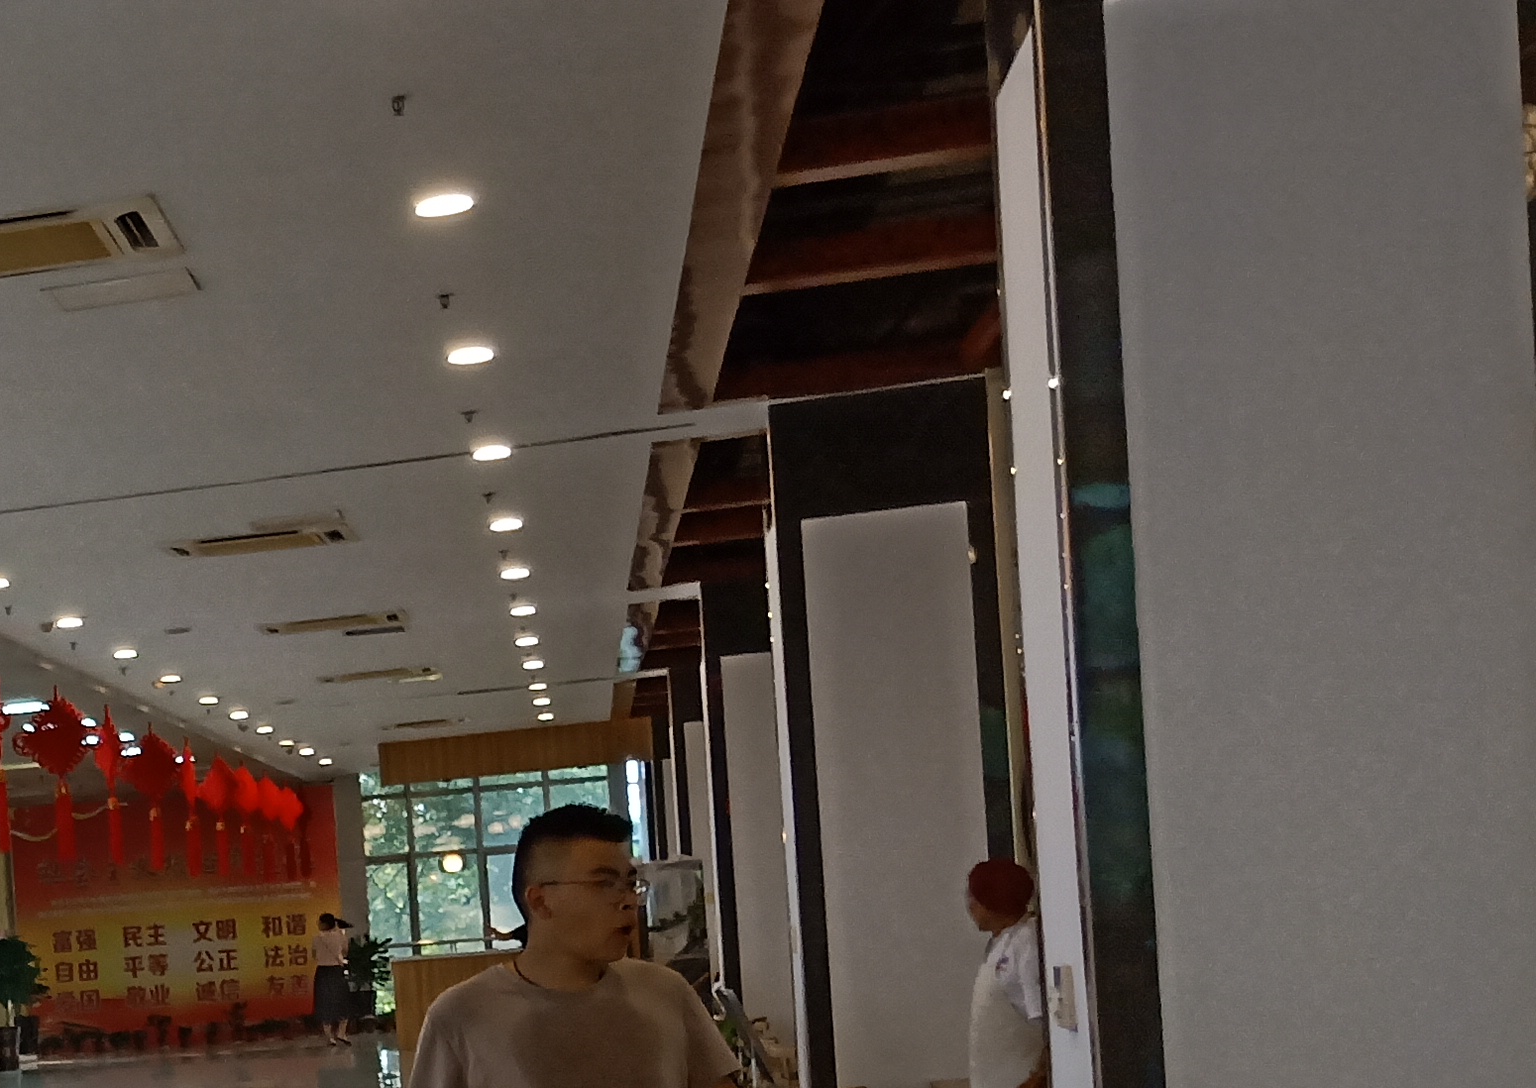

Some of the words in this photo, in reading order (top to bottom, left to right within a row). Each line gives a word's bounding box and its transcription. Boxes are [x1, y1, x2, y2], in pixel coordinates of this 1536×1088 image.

[52, 928, 97, 954] 富强
[122, 923, 167, 948] 民主
[192, 918, 238, 943] 文明
[261, 914, 307, 938] 和谐
[54, 959, 99, 983] 自由
[124, 953, 169, 978] 平等
[193, 949, 239, 974] 公正
[263, 944, 308, 968] 法治
